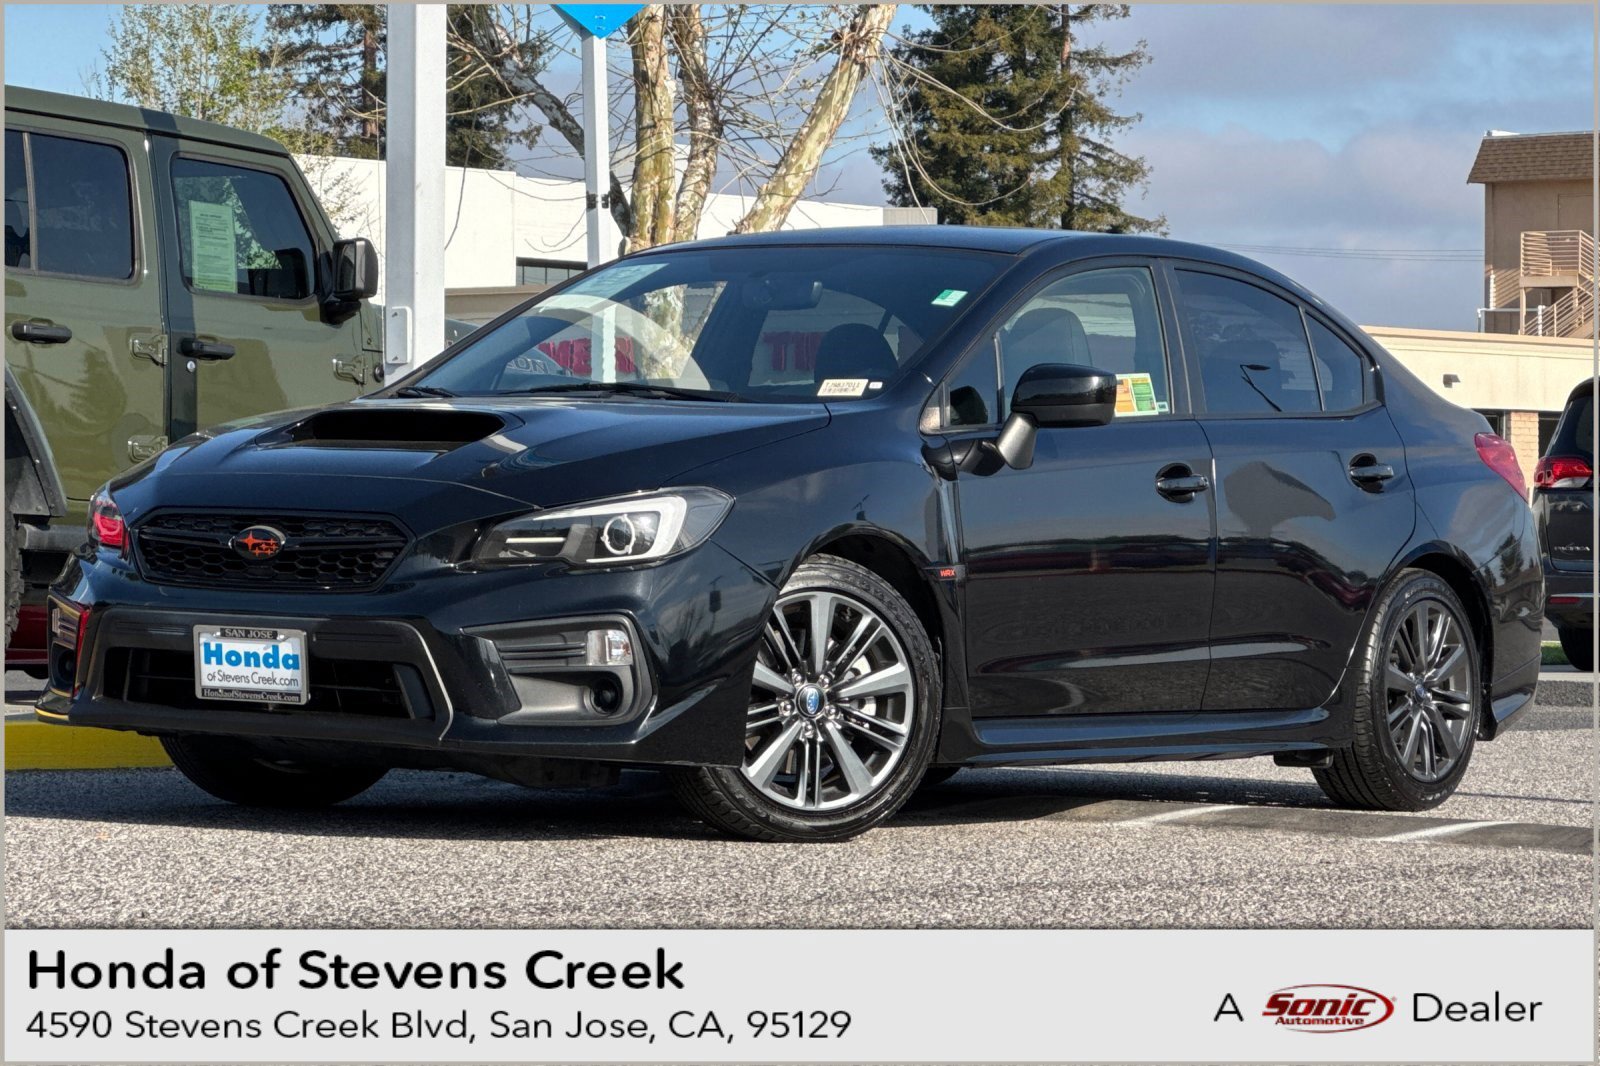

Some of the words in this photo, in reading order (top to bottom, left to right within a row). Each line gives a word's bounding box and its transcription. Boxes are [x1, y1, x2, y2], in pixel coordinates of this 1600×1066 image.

[940, 569, 955, 577] WRX
[225, 628, 246, 638] SAN
[247, 630, 273, 639] JOSE
[203, 642, 300, 670] Honda
[207, 672, 216, 682] of
